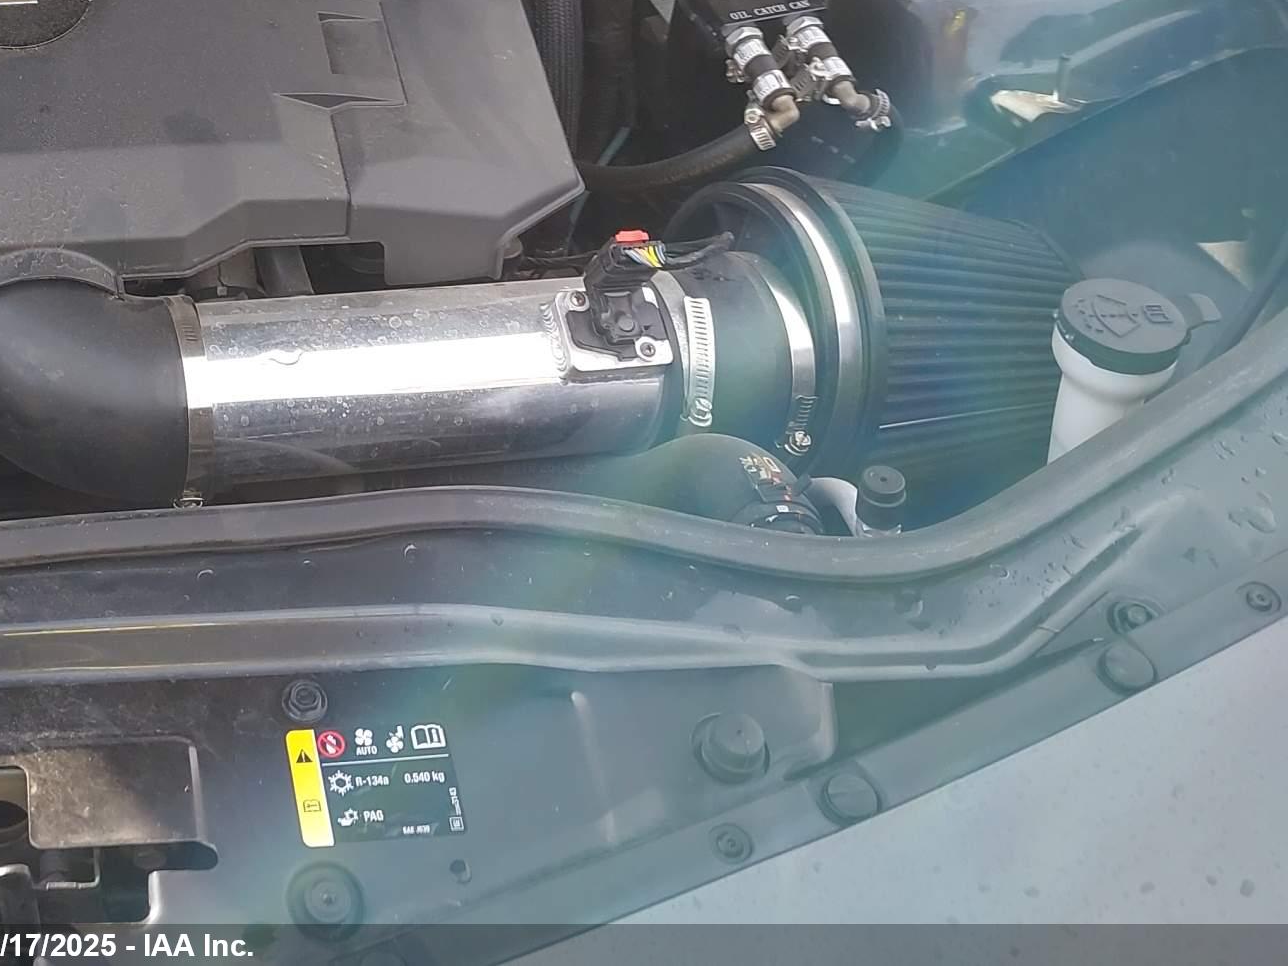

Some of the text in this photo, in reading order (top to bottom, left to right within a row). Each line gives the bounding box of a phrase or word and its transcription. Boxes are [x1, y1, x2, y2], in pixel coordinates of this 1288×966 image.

[729, 0, 810, 20] OIL CATCH CAN
[356, 746, 377, 756] AUTO
[355, 775, 389, 787] R-134a
[432, 770, 445, 783] kg
[363, 809, 384, 822] PAG
